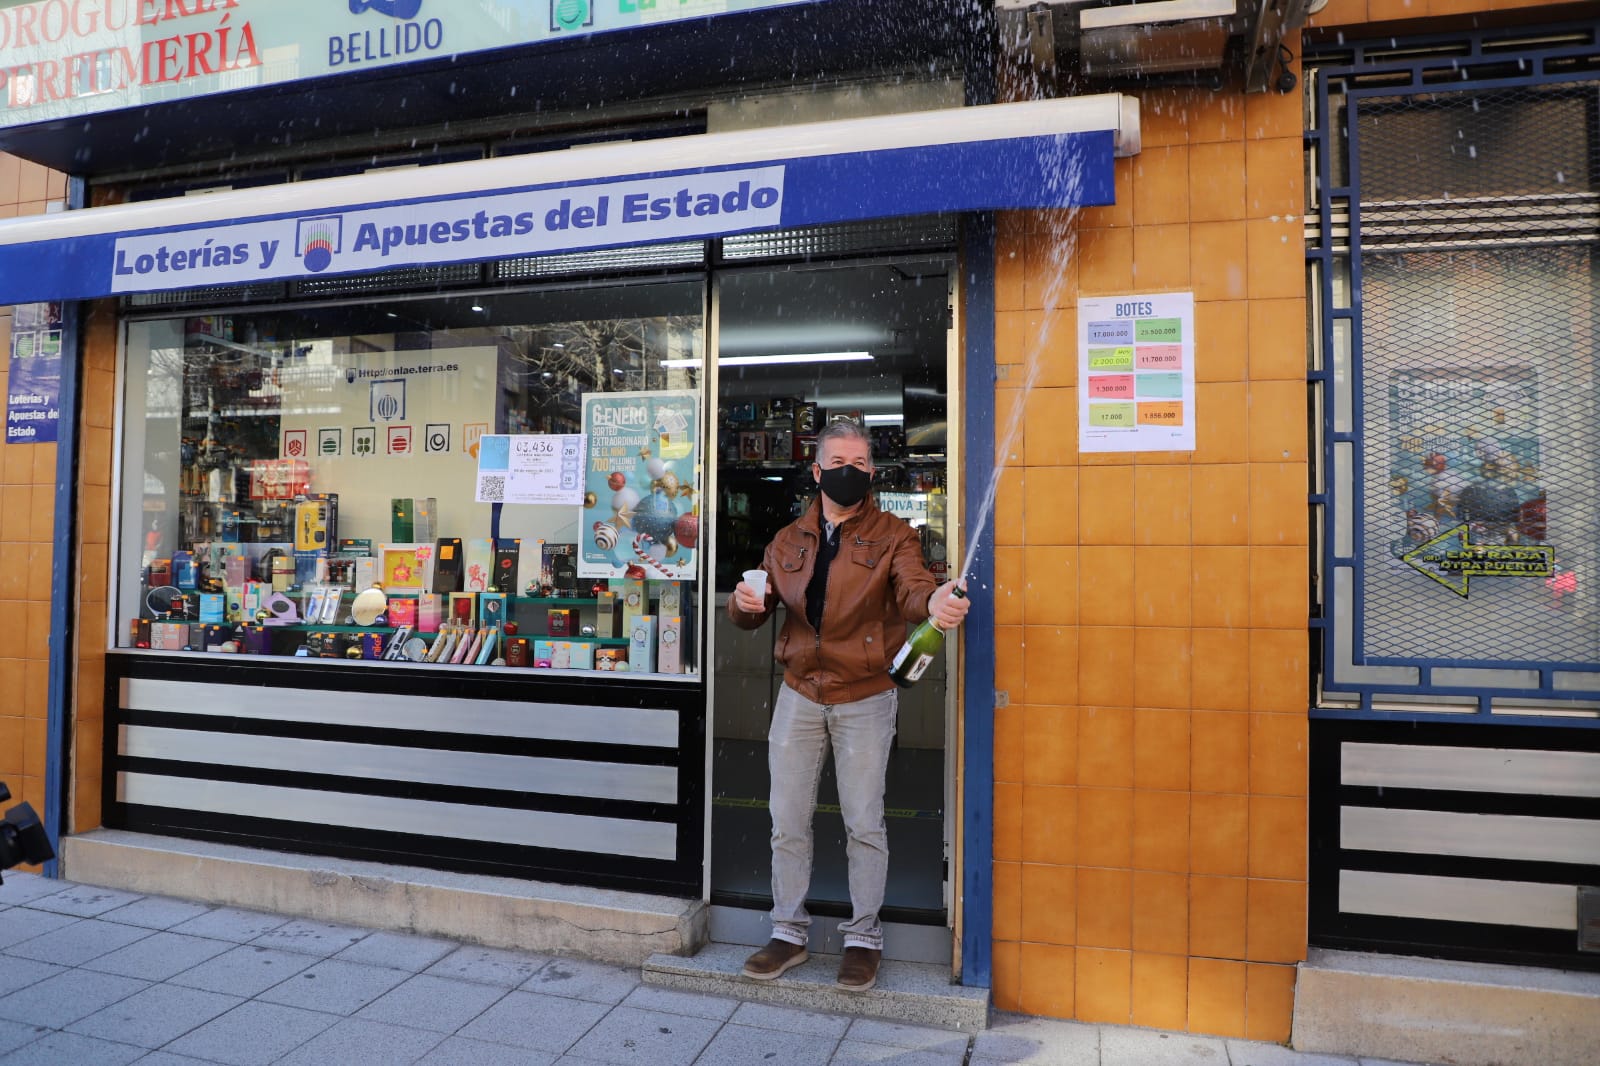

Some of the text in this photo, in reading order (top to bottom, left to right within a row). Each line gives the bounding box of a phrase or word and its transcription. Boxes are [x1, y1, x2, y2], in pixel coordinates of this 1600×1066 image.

[328, 18, 443, 66] BELLIDO
[0, 12, 263, 108] ERFUMERÍA
[115, 180, 779, 276] Loterías y Apuestas del Estado
[1116, 302, 1152, 316] BOTES
[9, 409, 46, 423] Apuestas
[605, 406, 648, 425] ENERO
[8, 425, 36, 437] Estado
[591, 457, 609, 473] 700
[1446, 551, 1542, 560] ENTRADA
[1440, 561, 1546, 571] OTRA PUERTA
